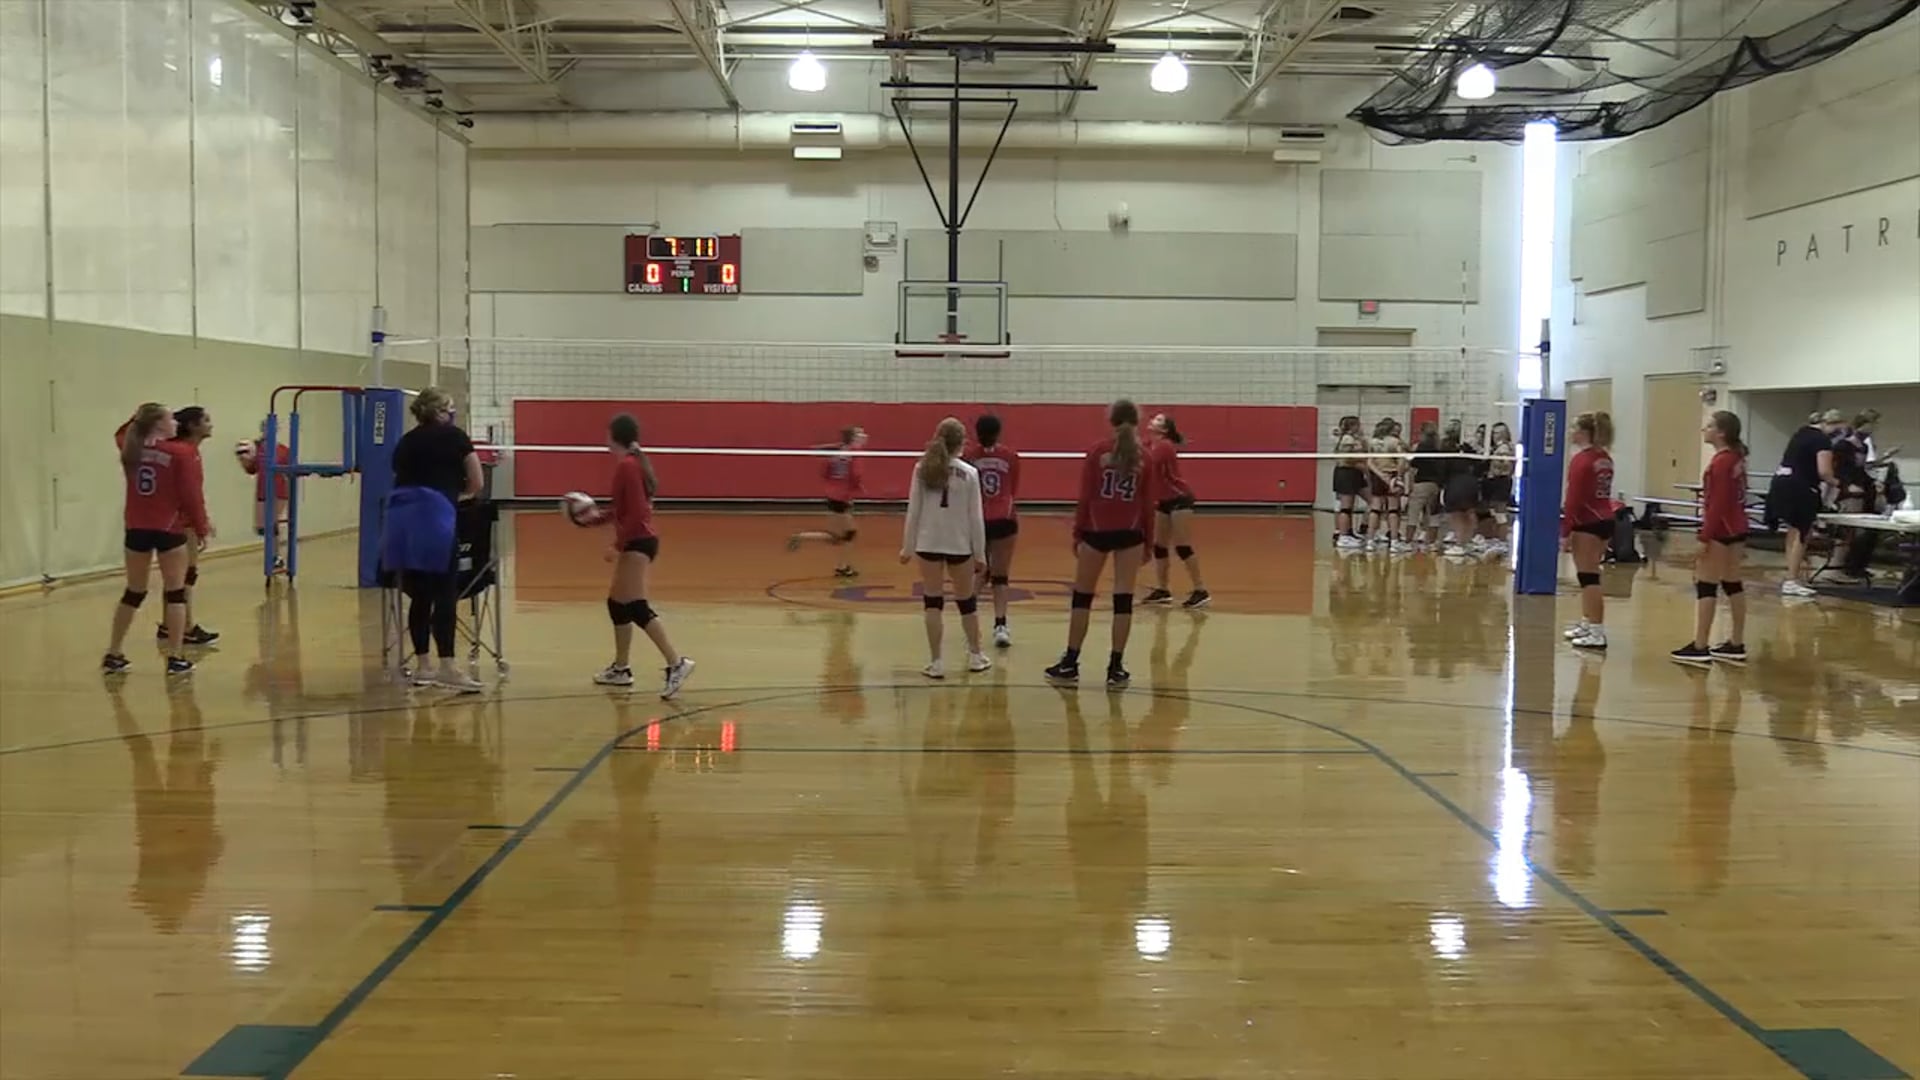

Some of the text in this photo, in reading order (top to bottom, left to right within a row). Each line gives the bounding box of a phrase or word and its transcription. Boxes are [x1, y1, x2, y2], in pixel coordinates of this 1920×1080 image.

[647, 263, 660, 283] 0
[722, 263, 735, 283] 0
[627, 283, 663, 293] CAJUNS
[683, 277, 689, 292] 1
[703, 283, 738, 293] VISITOR
[136, 465, 156, 496] 6
[983, 471, 1001, 497] 9
[1100, 468, 1138, 502] 14
